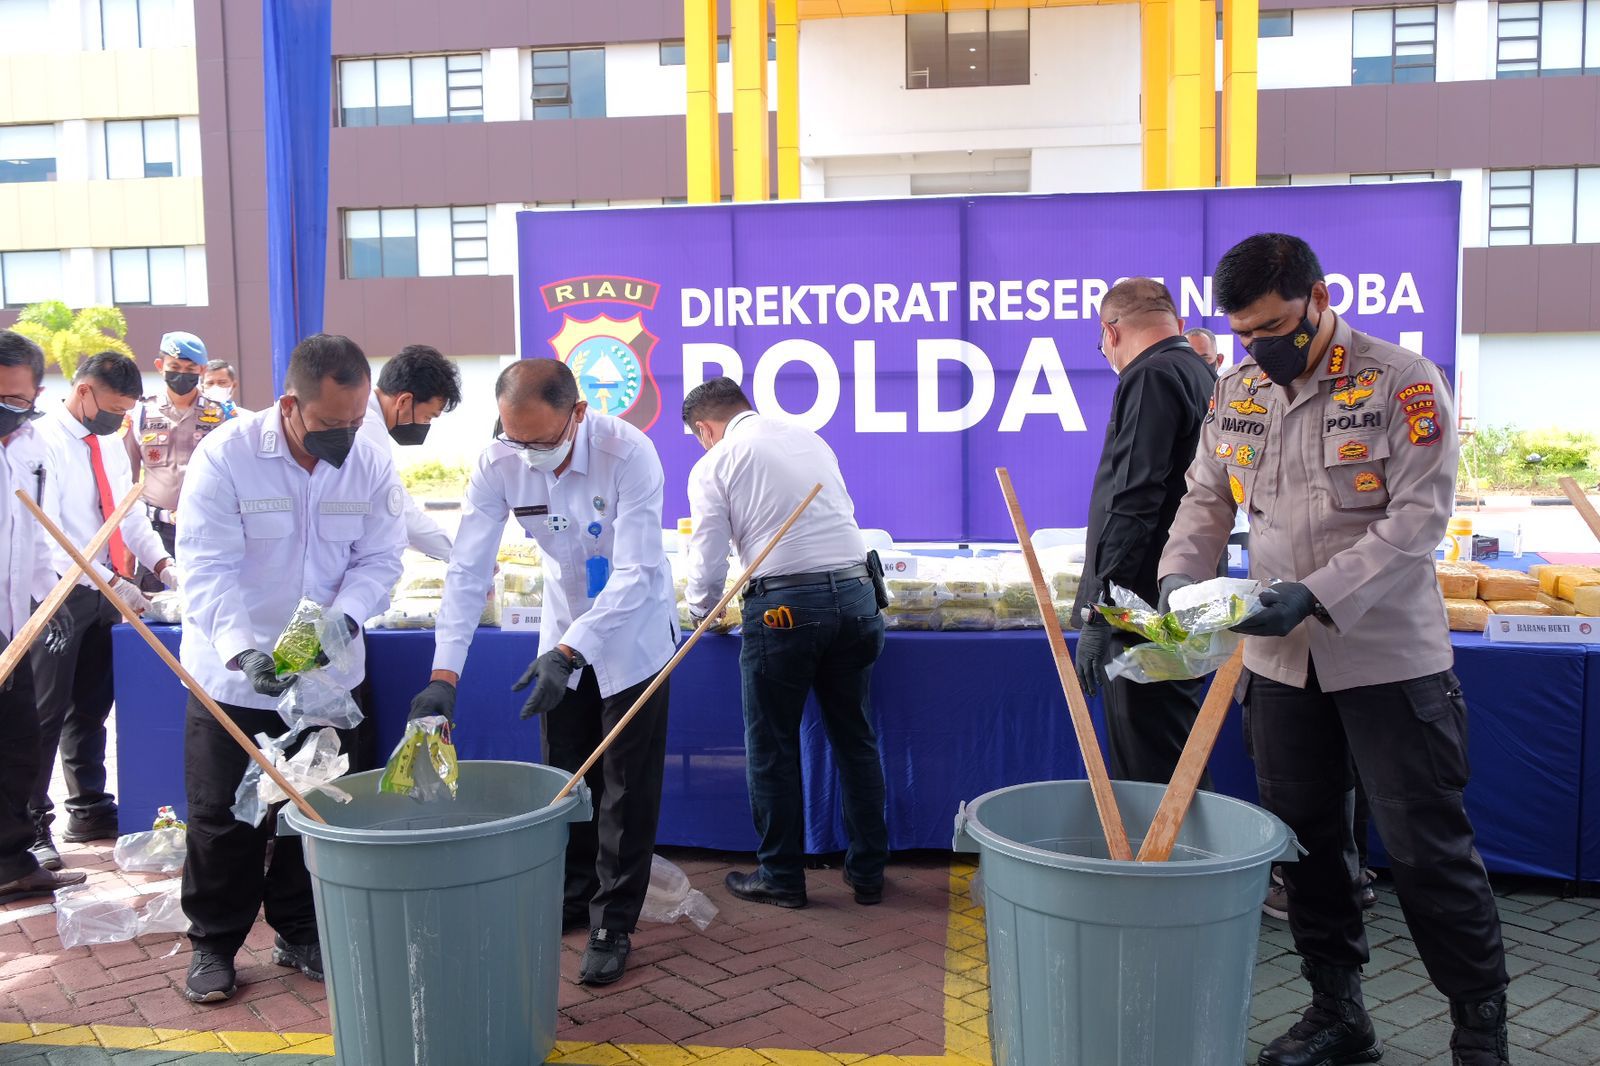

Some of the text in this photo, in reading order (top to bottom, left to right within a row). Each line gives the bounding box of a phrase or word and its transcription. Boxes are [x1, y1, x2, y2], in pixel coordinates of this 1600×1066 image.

[554, 281, 644, 303] RIAU
[681, 272, 1425, 328] DIREKTORAT RESER NOBA
[682, 336, 1088, 434] POLDA
[1399, 384, 1432, 400] POLDA
[1405, 401, 1433, 412] RIAU
[1221, 416, 1265, 436] NARTO
[1326, 411, 1382, 432] POLRI
[1517, 624, 1570, 633] BARANG BUKTI
